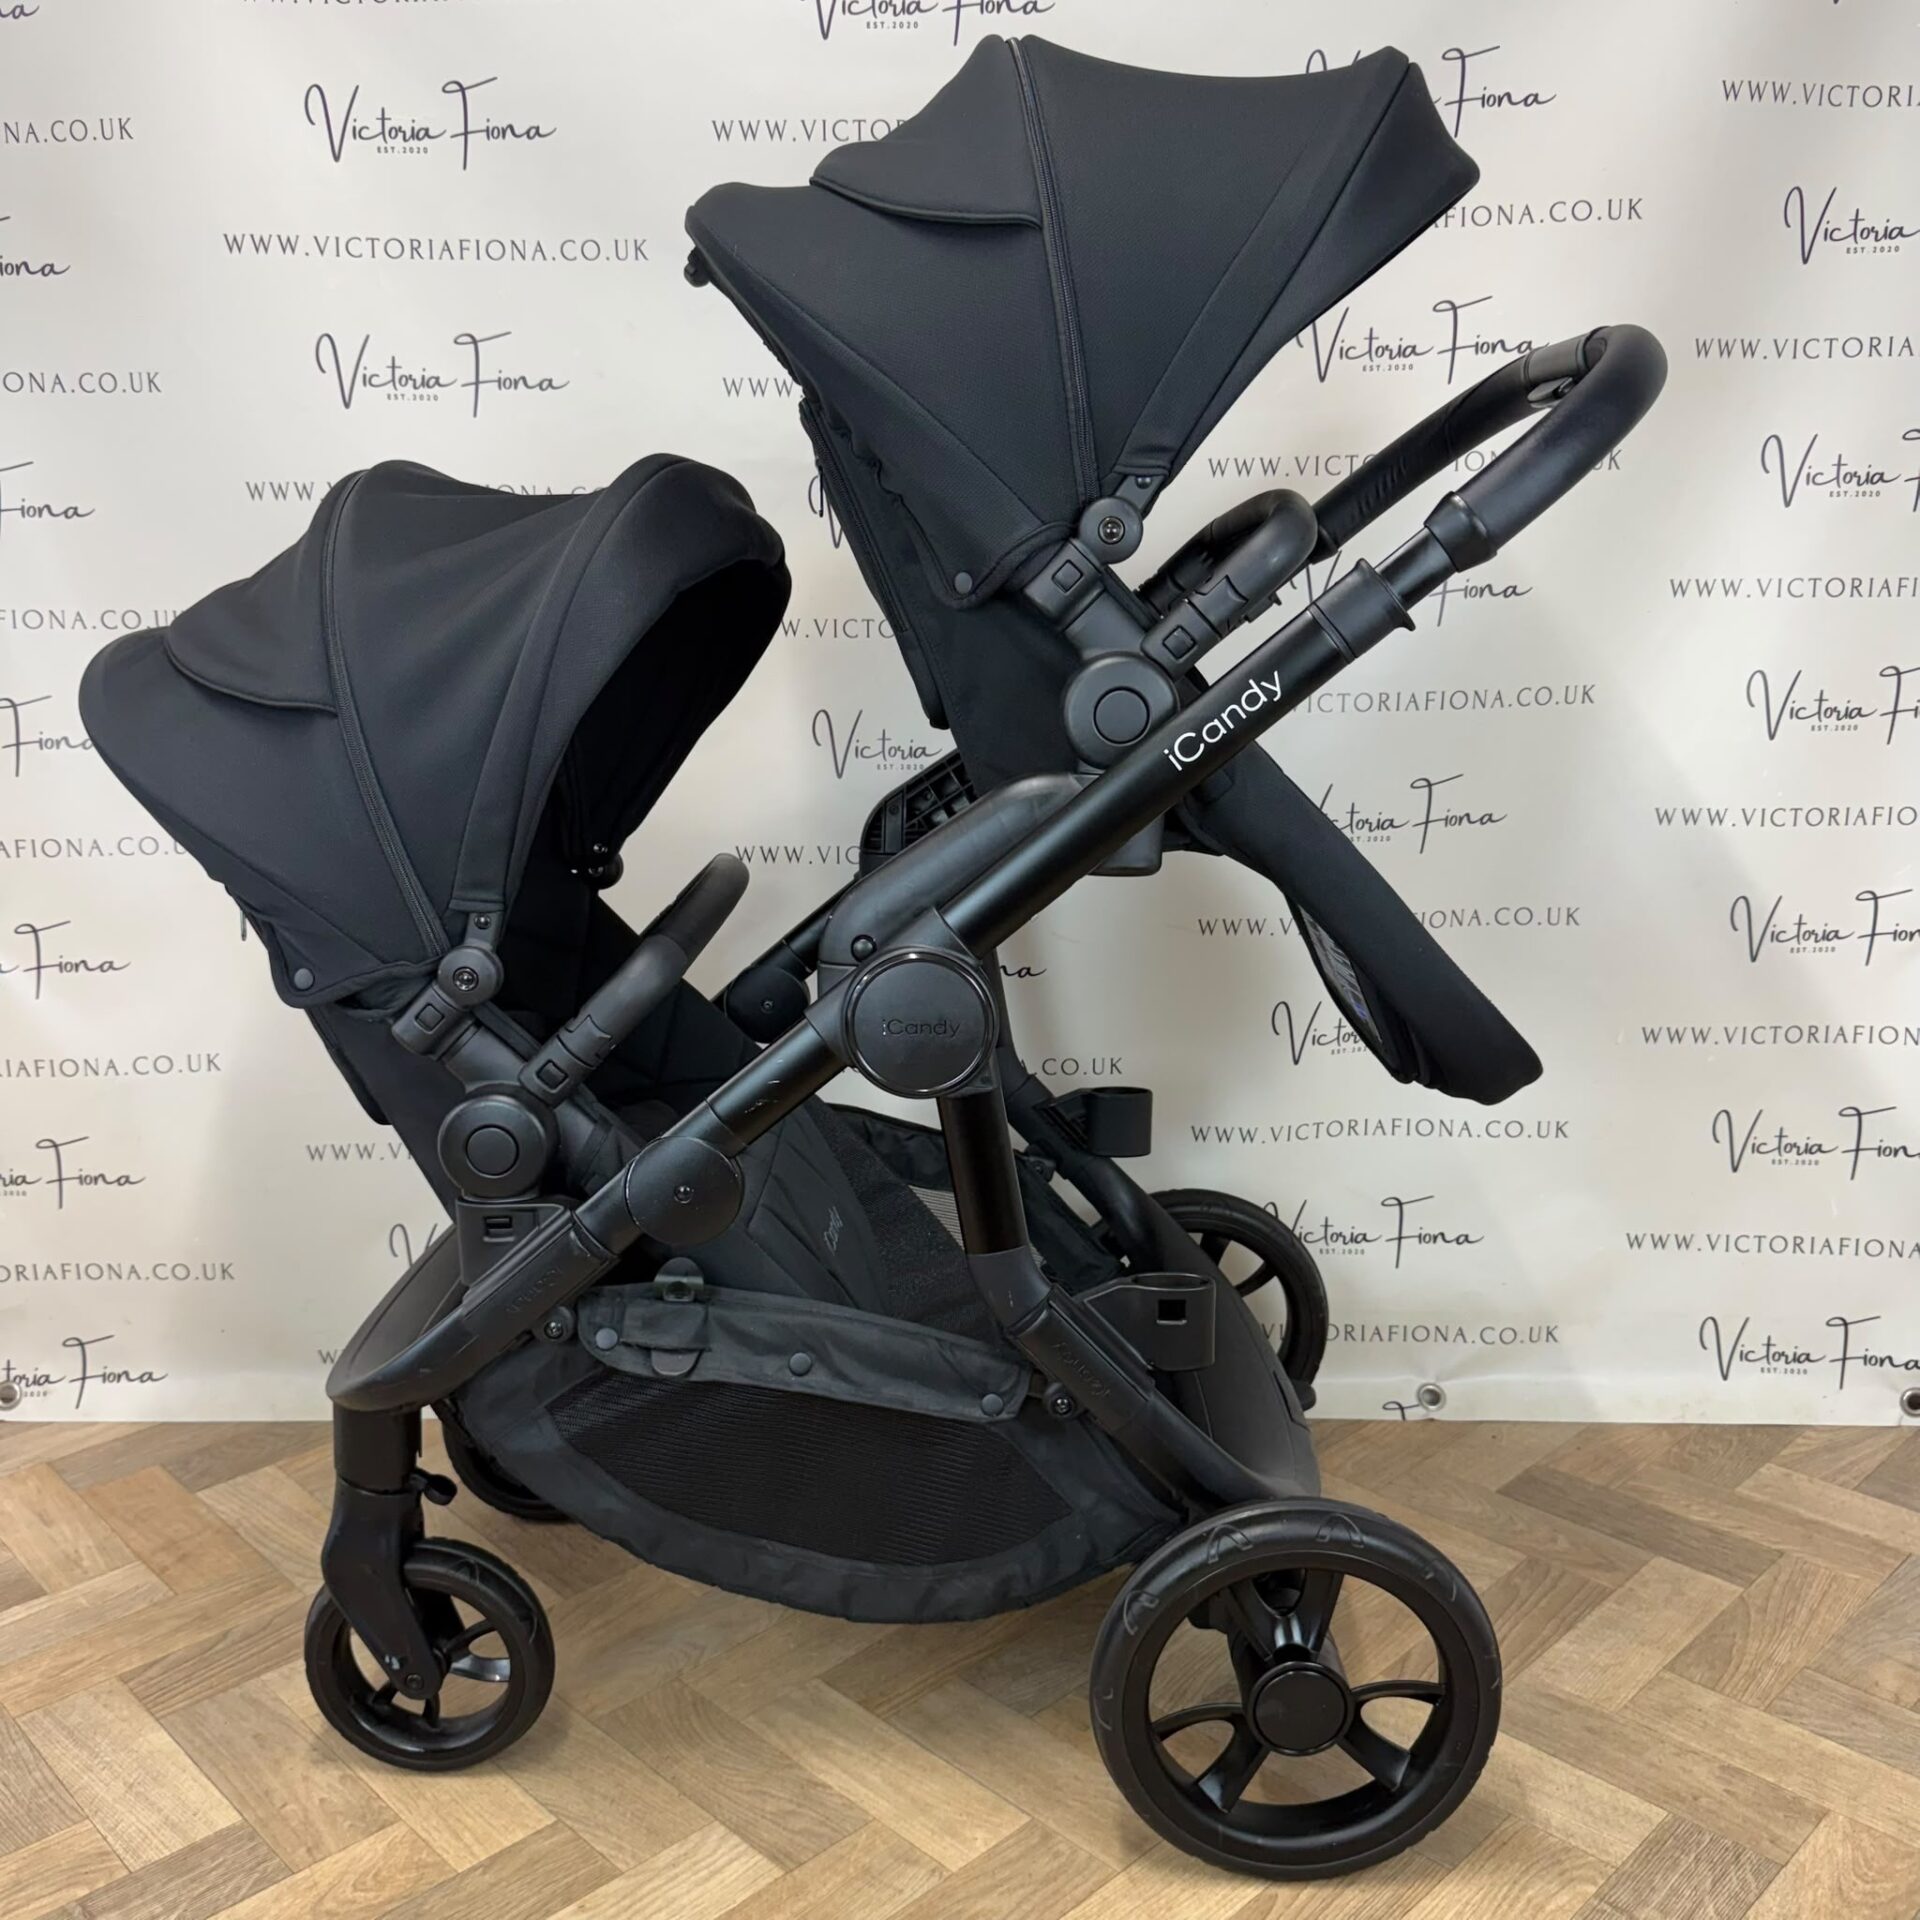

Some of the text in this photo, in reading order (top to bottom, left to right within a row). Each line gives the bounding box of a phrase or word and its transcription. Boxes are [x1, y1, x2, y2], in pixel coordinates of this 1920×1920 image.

[866, 21, 919, 29] EST.2020
[304, 76, 558, 171] Victoria Fiona
[1440, 45, 1557, 138] Fiona
[1722, 79, 1920, 109] WWW.VICTORI
[377, 146, 429, 154] EST.2020
[711, 119, 906, 142] WWW.VICTO
[1433, 197, 1643, 228] FIONA.CO.UK
[1783, 185, 1920, 265] Victoria
[222, 232, 650, 262] WWW.VICTORIAFIONA.CO.UK
[1845, 245, 1901, 254] EST.2020
[315, 331, 570, 418] Victoria Fiona
[1294, 295, 1551, 386] Victoria Fiona
[1362, 364, 1415, 372] EST.2020
[386, 393, 439, 402] EST.2020
[1760, 433, 1901, 509] Victoria
[1828, 489, 1882, 498] EST.2020
[1162, 669, 1284, 773] iCandy
[1292, 684, 1596, 714] ICTORIAFIONA.CO.UK
[1746, 668, 1878, 742] Victoria
[1810, 724, 1859, 733] EST.2020
[812, 708, 943, 779] Victoria
[1349, 835, 1391, 843] ST.2020
[1410, 773, 1508, 855] Fiona
[14, 920, 131, 1000] Fiona
[1730, 895, 1855, 963] Victoria
[881, 1018, 961, 1038] iCandy
[0, 1052, 222, 1078] IAFIONA.CO.UK
[1190, 1117, 1569, 1145] WWW.VICTORIAFIONA.CO.UK
[1712, 1105, 1920, 1183] Victoria Fion
[36, 1136, 147, 1210] Fiona
[1381, 1194, 1485, 1269] Fiona
[62, 1334, 169, 1410] Fiona
[1700, 1315, 1920, 1390] Victoria Fiona
